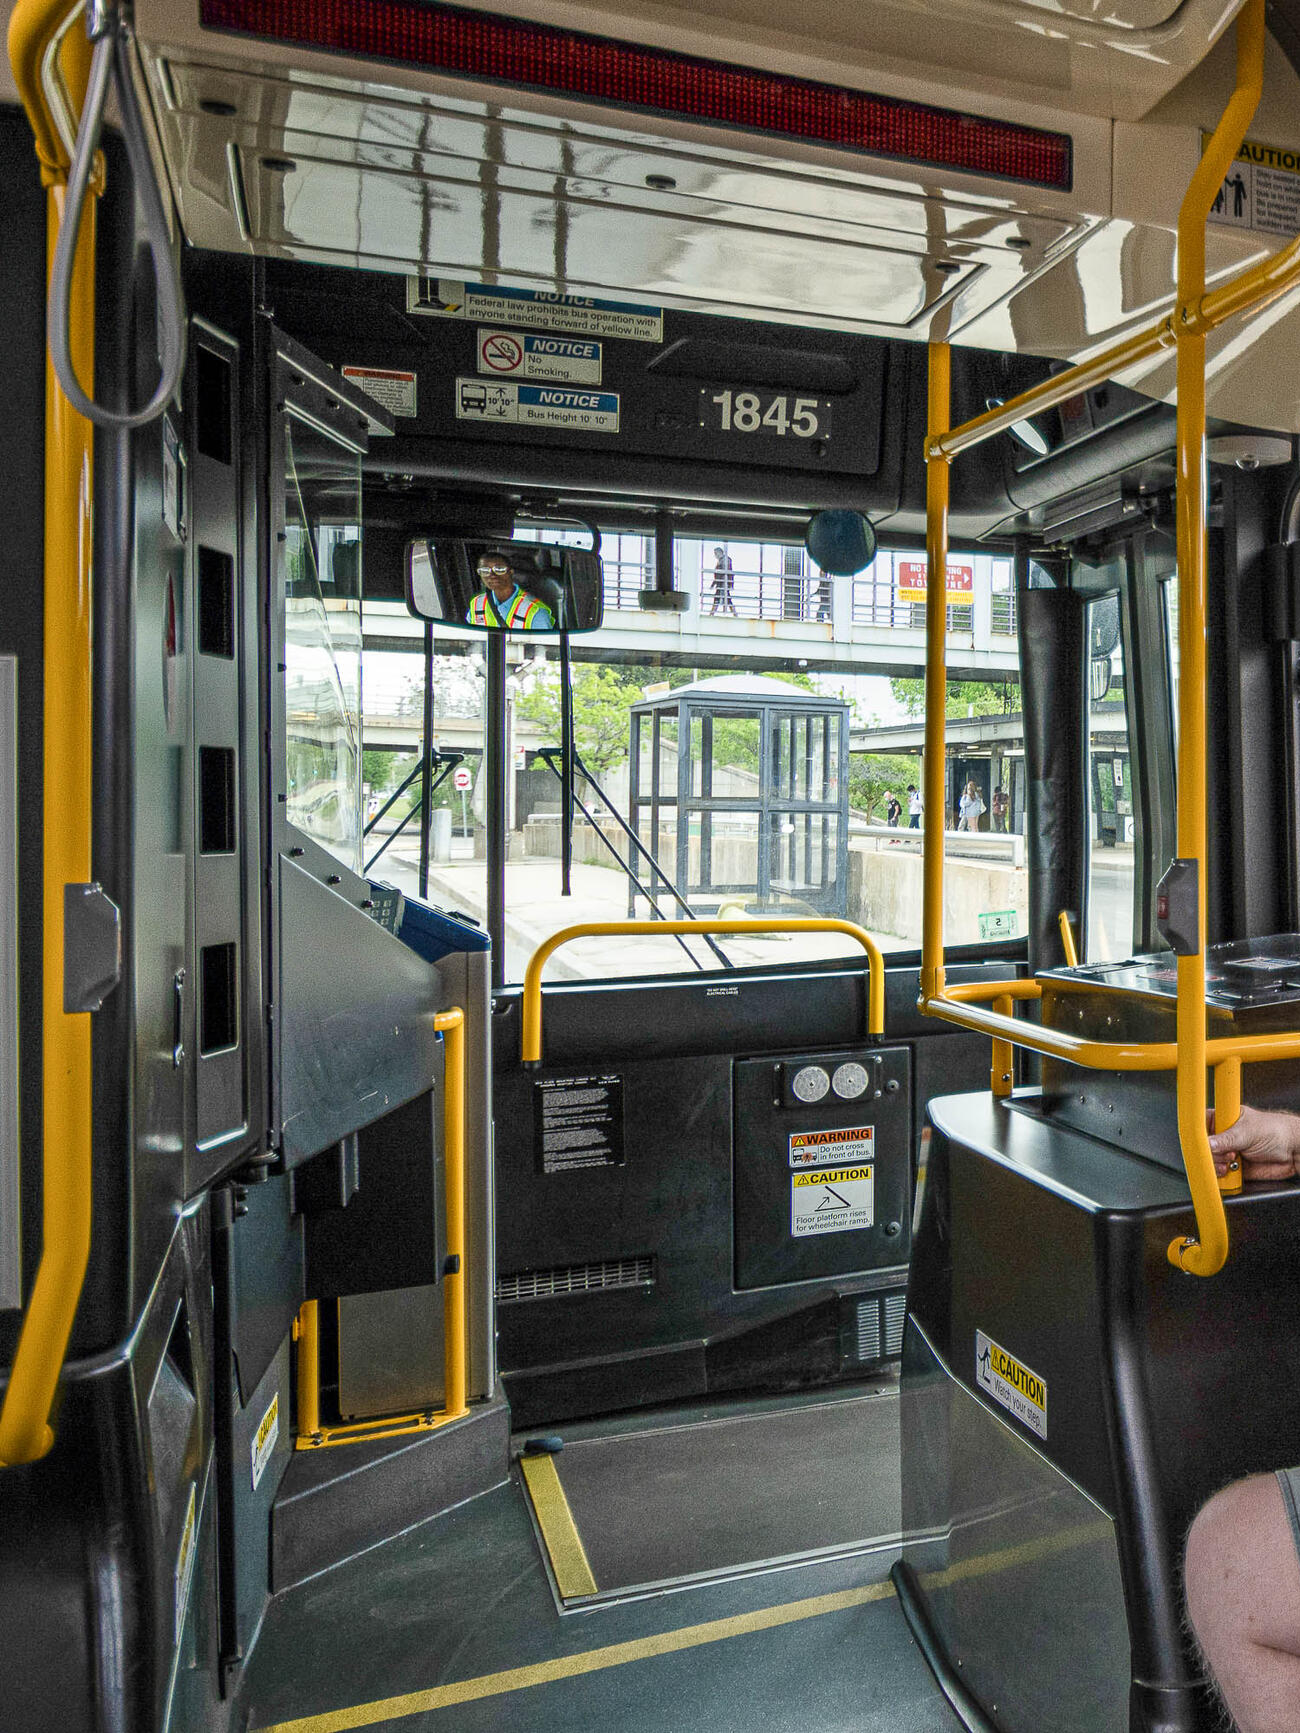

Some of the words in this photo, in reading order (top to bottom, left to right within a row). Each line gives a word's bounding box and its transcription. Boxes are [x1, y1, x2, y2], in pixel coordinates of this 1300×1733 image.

[534, 291, 594, 307] NOTICE
[469, 296, 506, 308] Federal
[507, 301, 524, 312] law
[526, 302, 570, 318] prohibits
[571, 306, 588, 318] bus
[590, 311, 634, 326] operation
[636, 317, 656, 327] with
[469, 308, 505, 321] anyone
[508, 311, 550, 326] standing
[551, 316, 588, 330] forward
[590, 320, 600, 331] of
[601, 322, 632, 336] yellow
[634, 325, 653, 338] line.
[532, 339, 594, 358] NOTICE
[528, 355, 542, 364] No
[527, 365, 572, 379] Smoking.
[539, 391, 600, 408] NOTICE
[527, 410, 545, 420] Bus
[547, 411, 578, 424] Height
[712, 391, 818, 438] 1845
[806, 1129, 870, 1144] WARNING
[820, 1145, 830, 1154] Do
[832, 1144, 844, 1152] not
[846, 1142, 865, 1151] cross
[828, 1150, 846, 1160] front
[848, 1150, 856, 1158] of
[856, 1148, 870, 1156] bus.
[810, 1168, 869, 1184] CAUTION
[796, 1216, 816, 1224] Floor
[816, 1212, 848, 1224] platform
[850, 1210, 867, 1218] rises
[796, 1224, 806, 1232] for
[808, 1219, 848, 1231] wheelchair
[848, 1218, 870, 1226] ramp.
[1000, 1354, 1044, 1407] CAUTION
[994, 1378, 1012, 1401] Watch
[1012, 1395, 1026, 1413] your
[1027, 1408, 1042, 1429] step.
